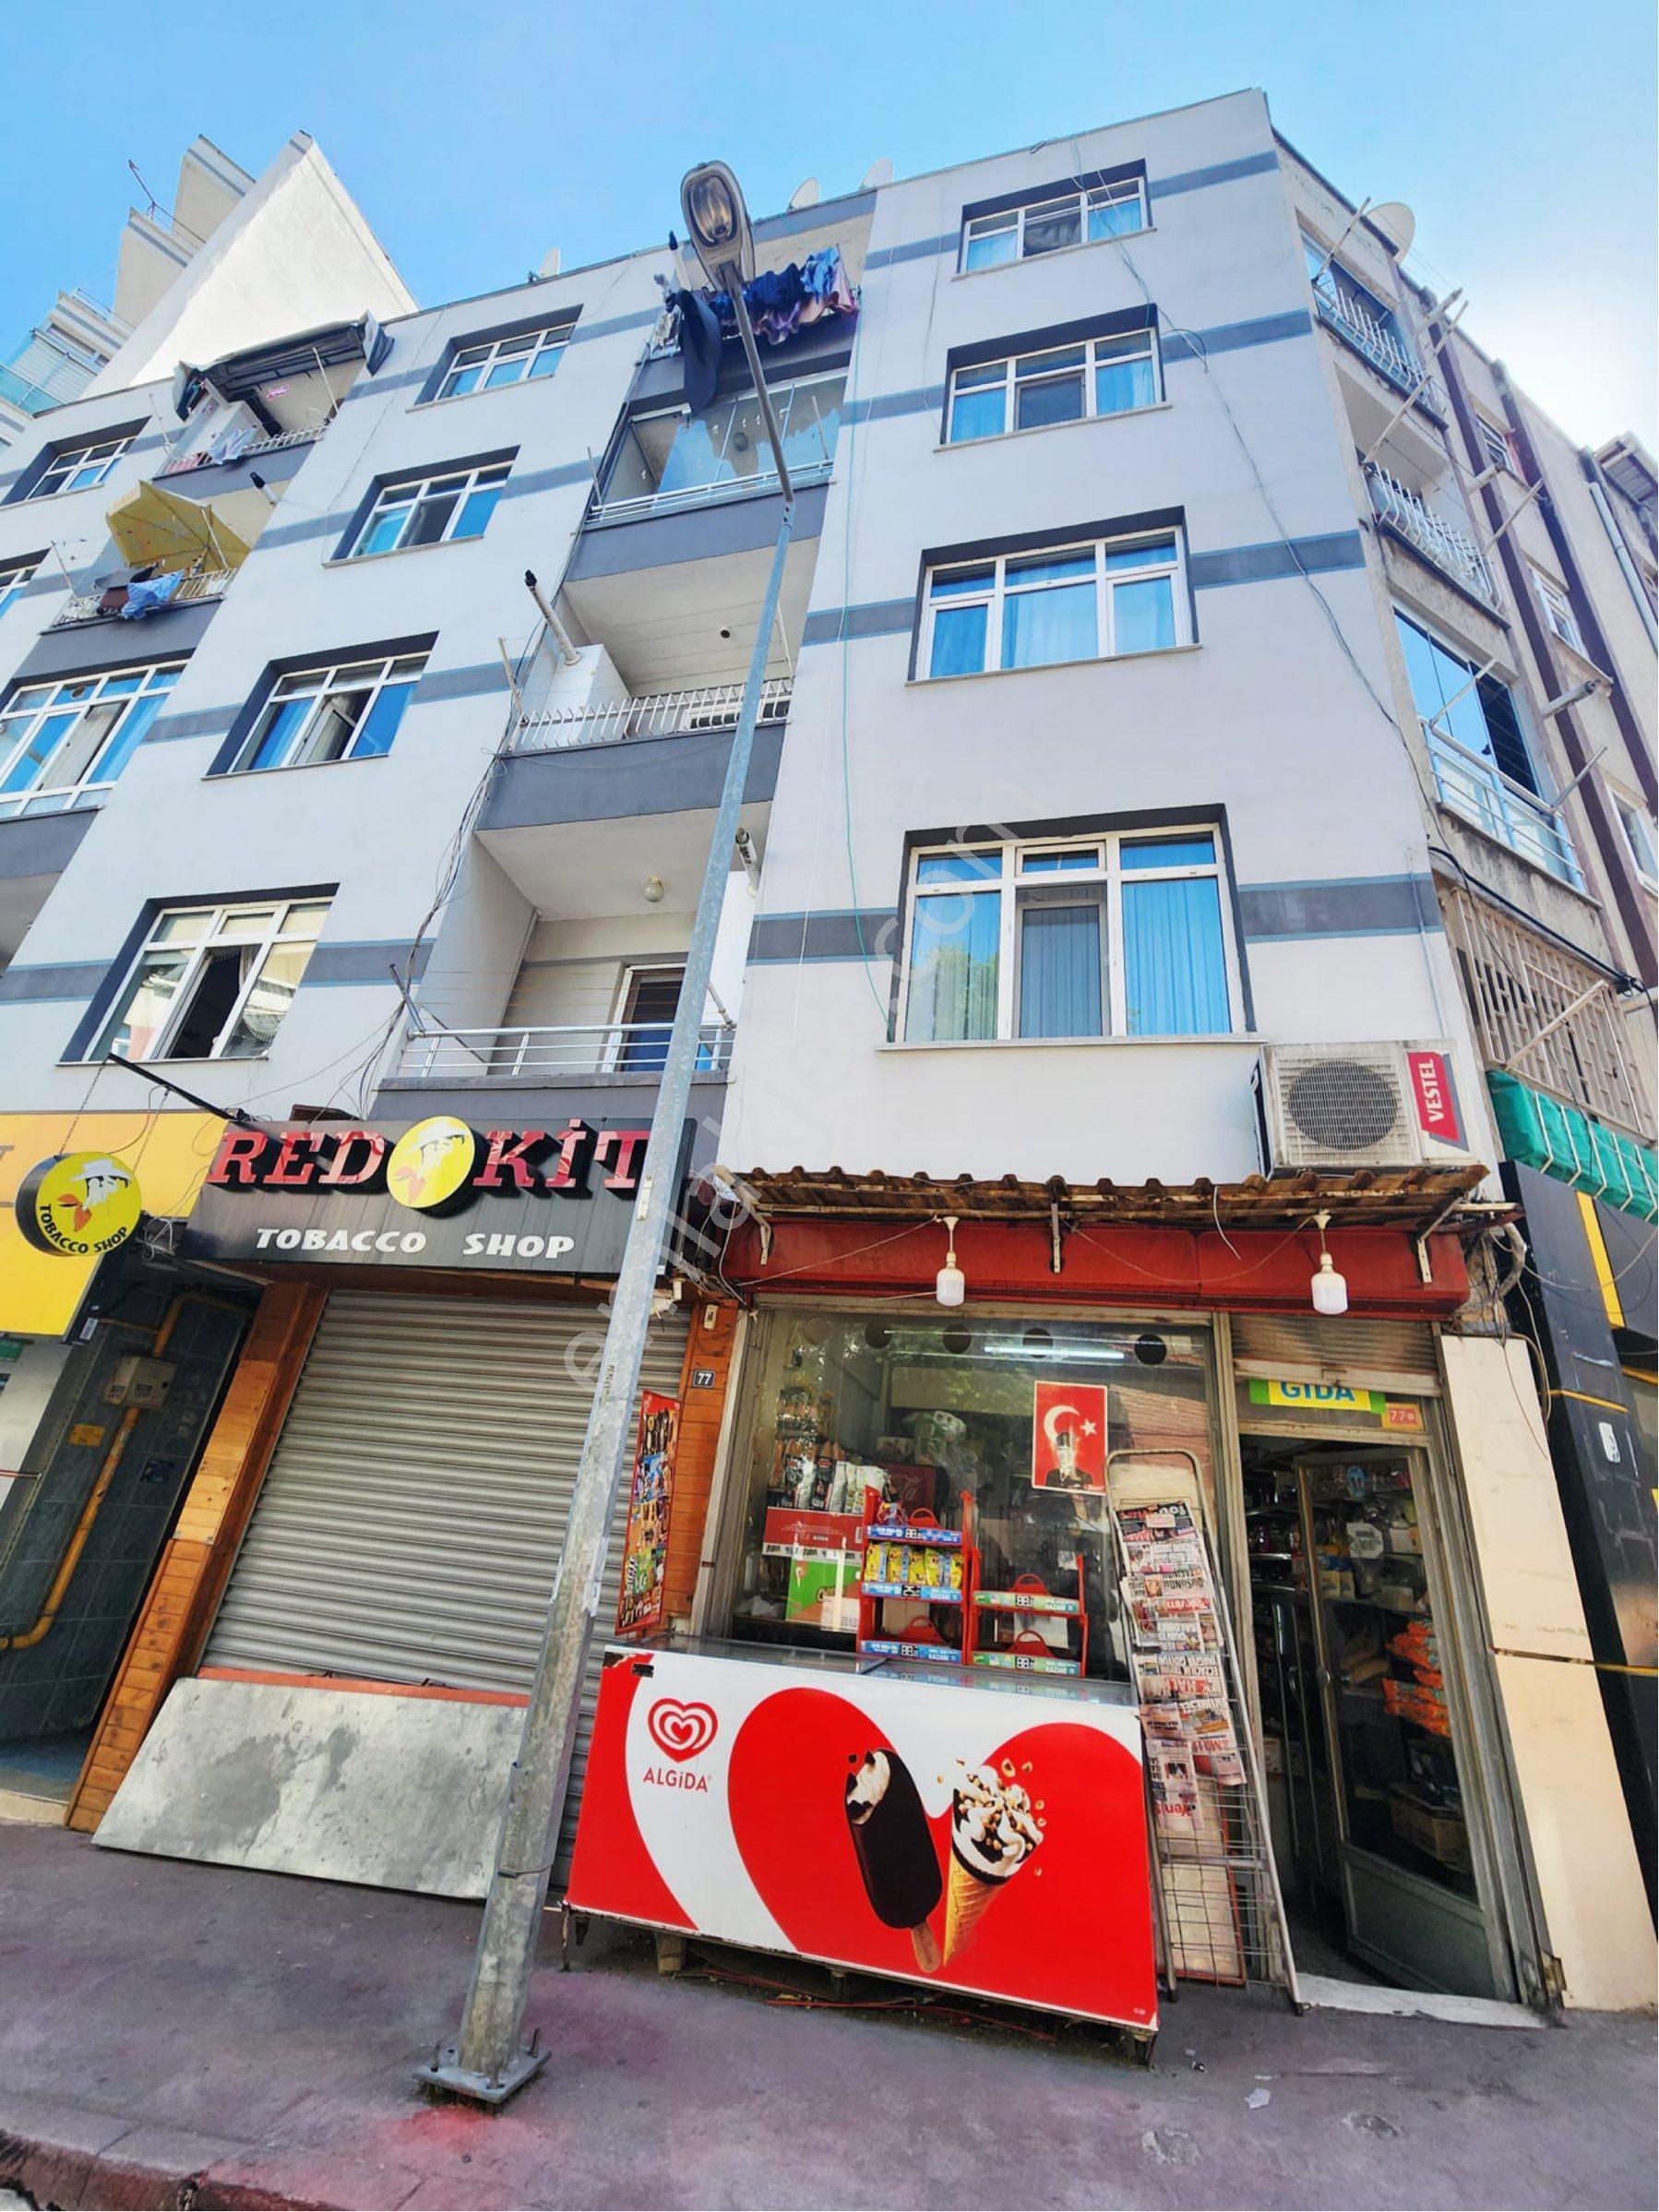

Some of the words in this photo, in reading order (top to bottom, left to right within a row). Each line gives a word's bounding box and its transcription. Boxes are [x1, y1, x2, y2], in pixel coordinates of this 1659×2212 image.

[1419, 1058, 1445, 1123] VESTEL
[206, 1130, 386, 1185] RED
[40, 1203, 90, 1253] TOBACCO
[93, 1226, 127, 1252] SHOP
[256, 1227, 427, 1253] TOBACCO
[462, 1231, 576, 1259] SHOP
[696, 1370, 713, 1385] 77
[1280, 1381, 1355, 1402] GIDA
